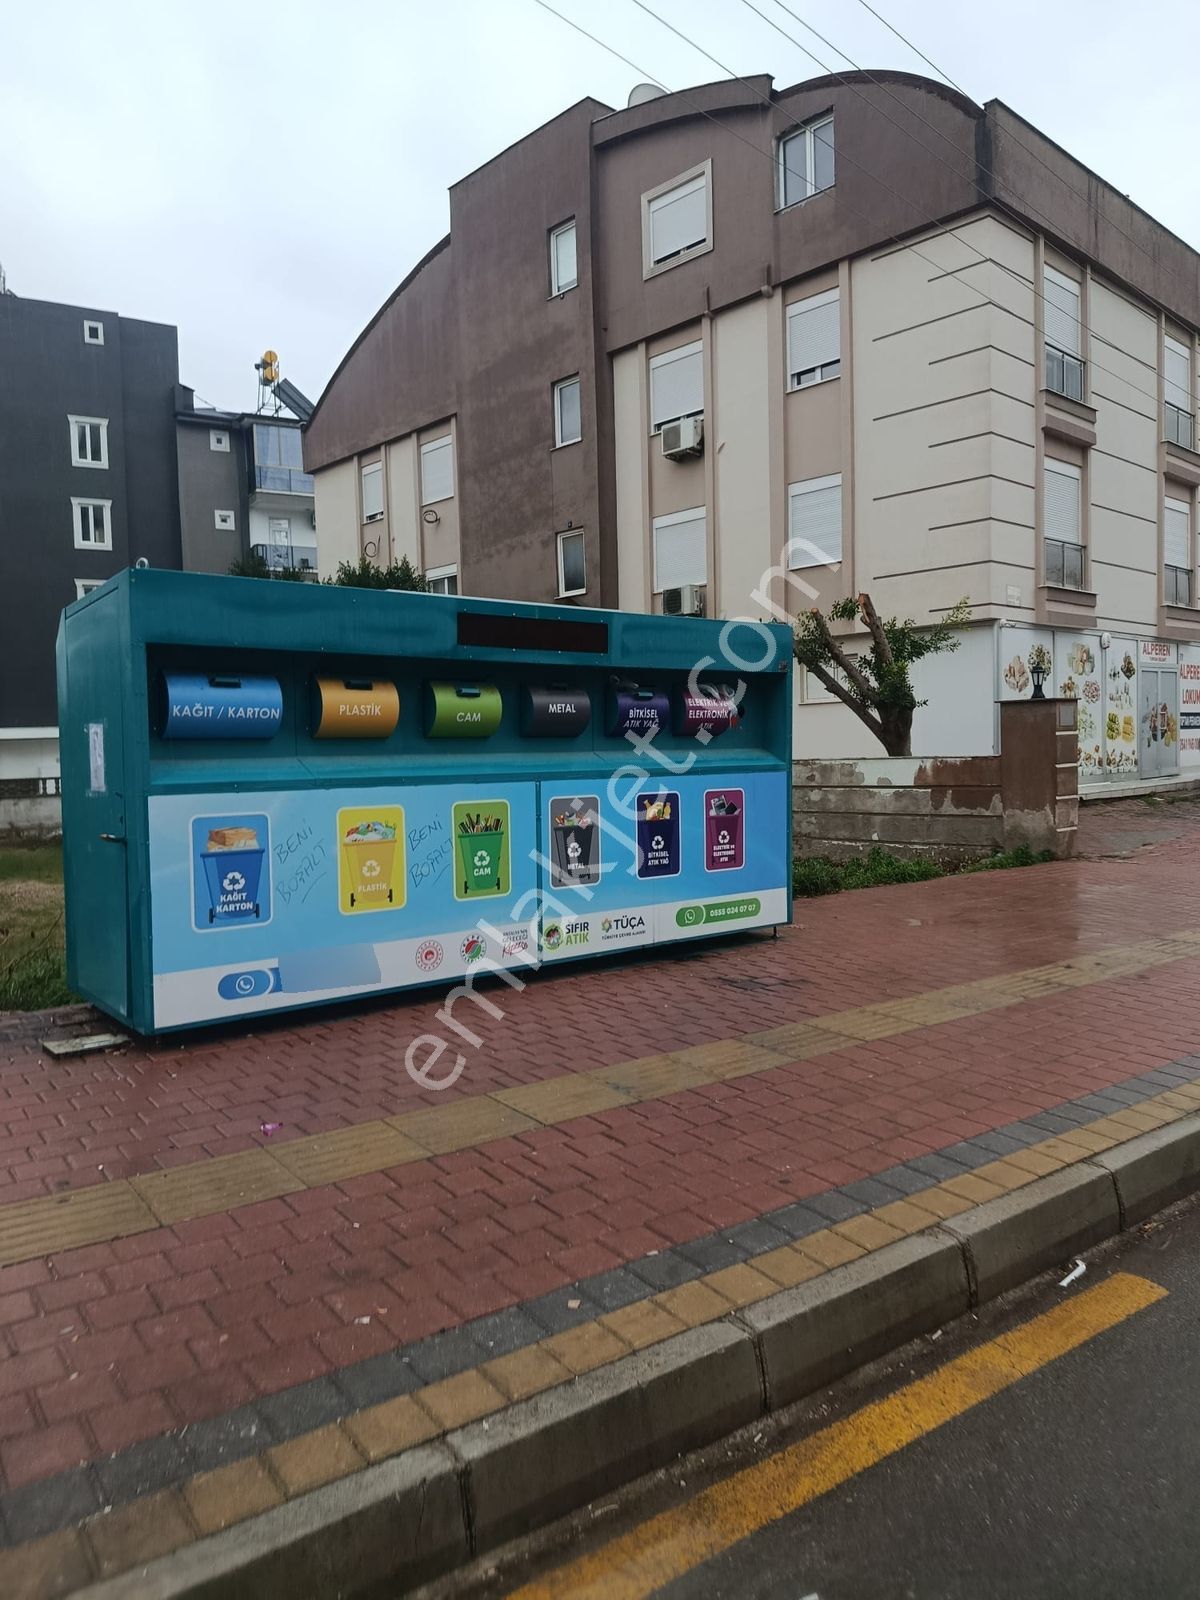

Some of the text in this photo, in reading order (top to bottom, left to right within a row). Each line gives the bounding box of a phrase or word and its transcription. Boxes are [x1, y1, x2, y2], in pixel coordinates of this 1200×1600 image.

[1142, 643, 1171, 656] ALPEREN
[172, 702, 280, 719] KAĞIT / KARTON
[339, 702, 381, 716] PLASTİK
[548, 703, 576, 714] METAL
[629, 707, 658, 719] BİTKİSEL
[688, 709, 730, 719] ELEKTRONİK
[456, 712, 481, 723] CAM
[623, 719, 641, 728] ATIK
[474, 867, 491, 876] CAM
[357, 883, 388, 893] PLASTİK
[220, 890, 247, 903] KAĞIT
[216, 902, 253, 914] KARTON
[565, 921, 589, 934] SIFIR
[613, 915, 645, 930] TÜÇA
[565, 932, 589, 945] ATIK
